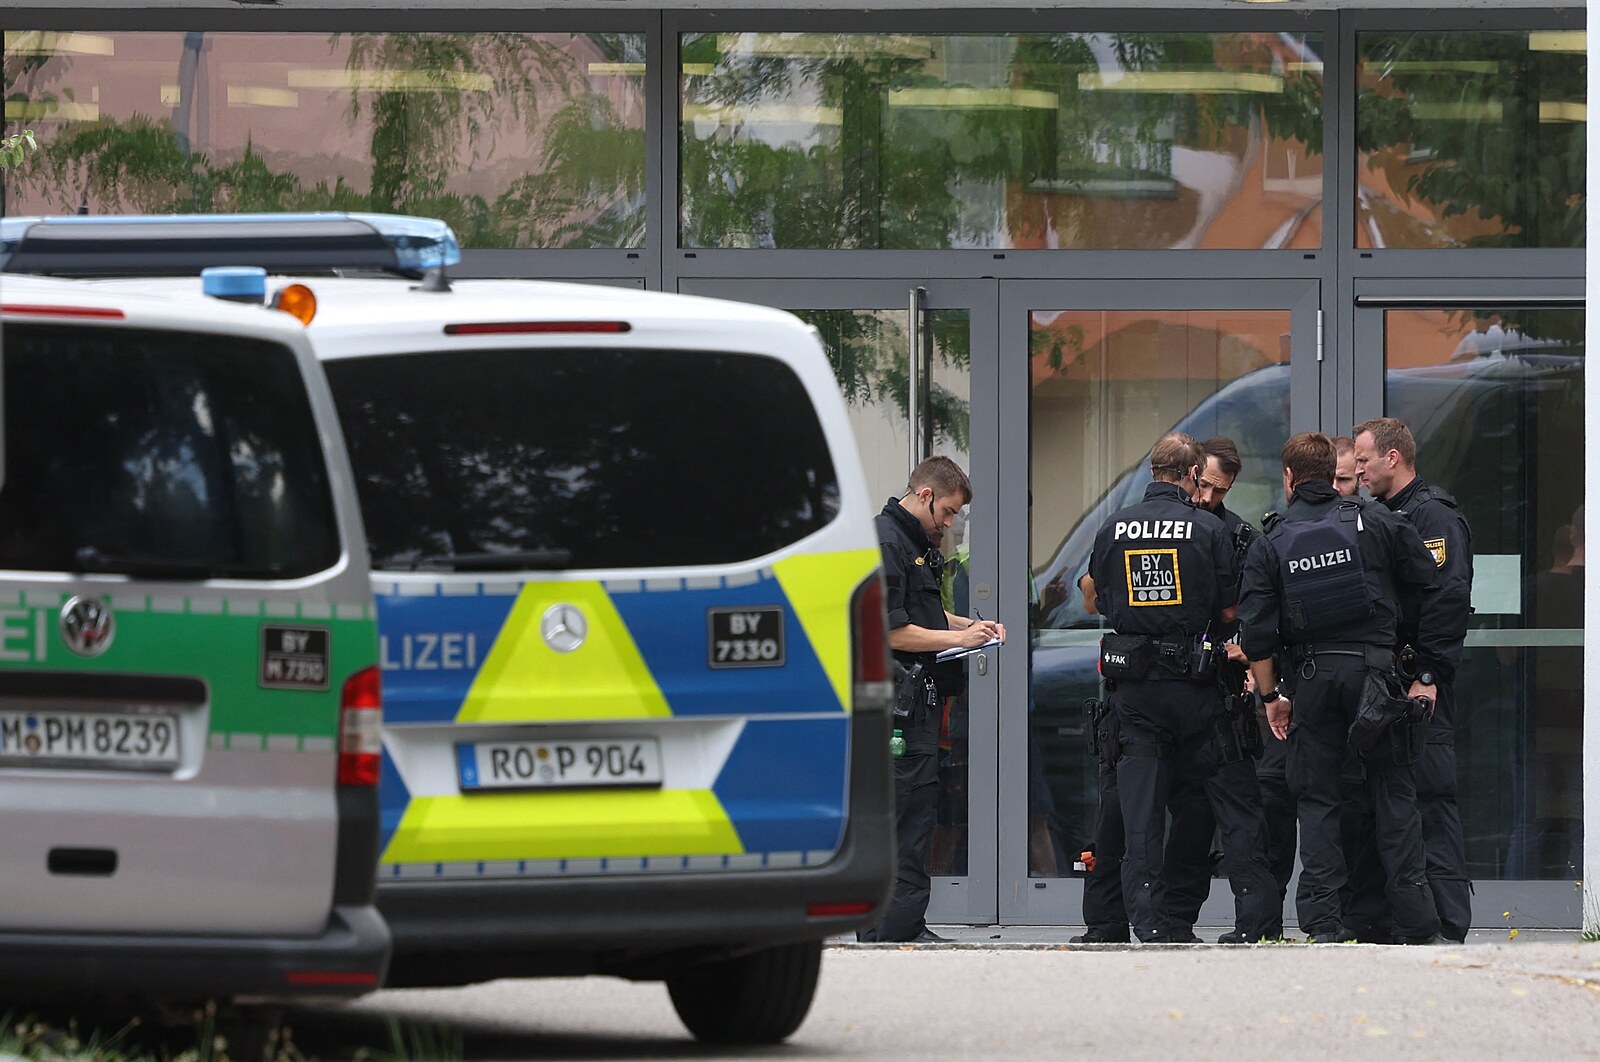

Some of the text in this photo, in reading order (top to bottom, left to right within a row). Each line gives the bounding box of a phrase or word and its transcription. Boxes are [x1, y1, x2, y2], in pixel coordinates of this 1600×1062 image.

[1114, 520, 1193, 540] POLIZEI
[1424, 541, 1443, 549] OLIZEI
[1141, 554, 1161, 571] BY
[1288, 548, 1352, 574] POLIZEI
[1132, 570, 1173, 587] M 7310
[729, 612, 762, 635] BY
[281, 630, 310, 653] BY
[380, 632, 476, 670] LIZEI
[716, 639, 778, 661] 7330
[1111, 654, 1126, 665] IFAK
[1, 717, 171, 755] M PM 8239
[491, 744, 646, 780] RO P 904
